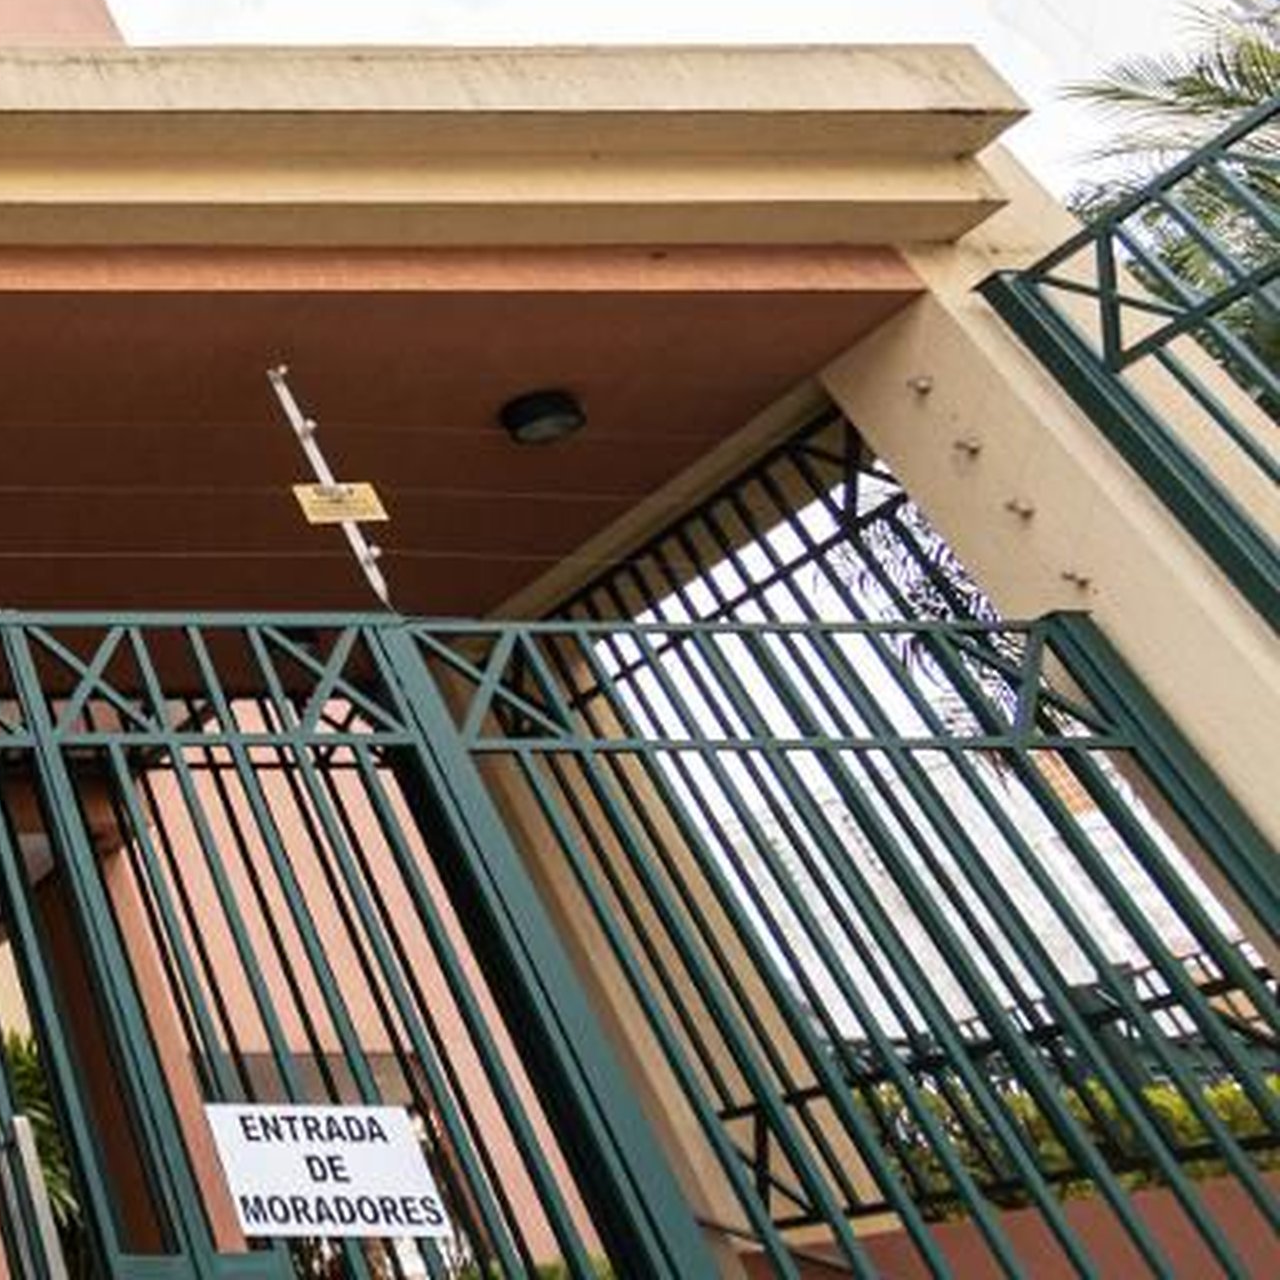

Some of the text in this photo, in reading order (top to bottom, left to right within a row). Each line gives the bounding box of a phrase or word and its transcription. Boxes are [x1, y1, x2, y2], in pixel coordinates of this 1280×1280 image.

[239, 1115, 387, 1143] ENTRADA
[305, 1155, 351, 1183] DE
[239, 1195, 444, 1226] MORADORES
